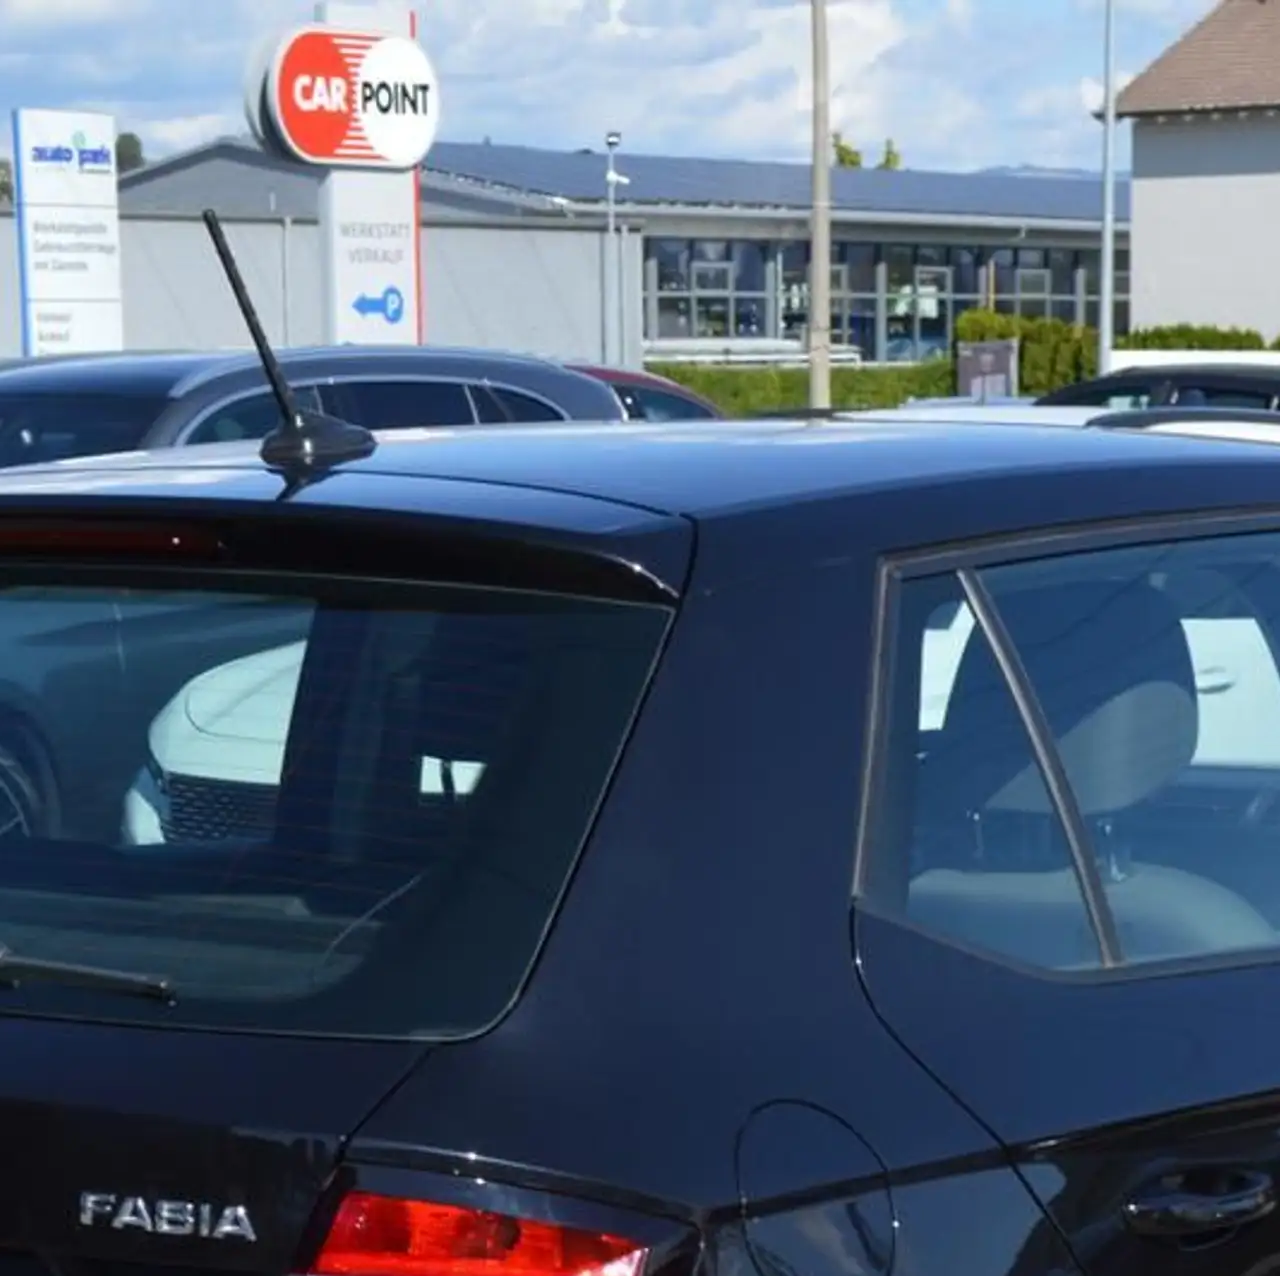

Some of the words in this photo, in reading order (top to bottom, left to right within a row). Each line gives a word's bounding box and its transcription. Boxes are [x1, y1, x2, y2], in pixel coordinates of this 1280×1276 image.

[293, 74, 349, 113] CAR
[361, 80, 430, 115] POINT
[78, 1191, 258, 1242] FABIA
